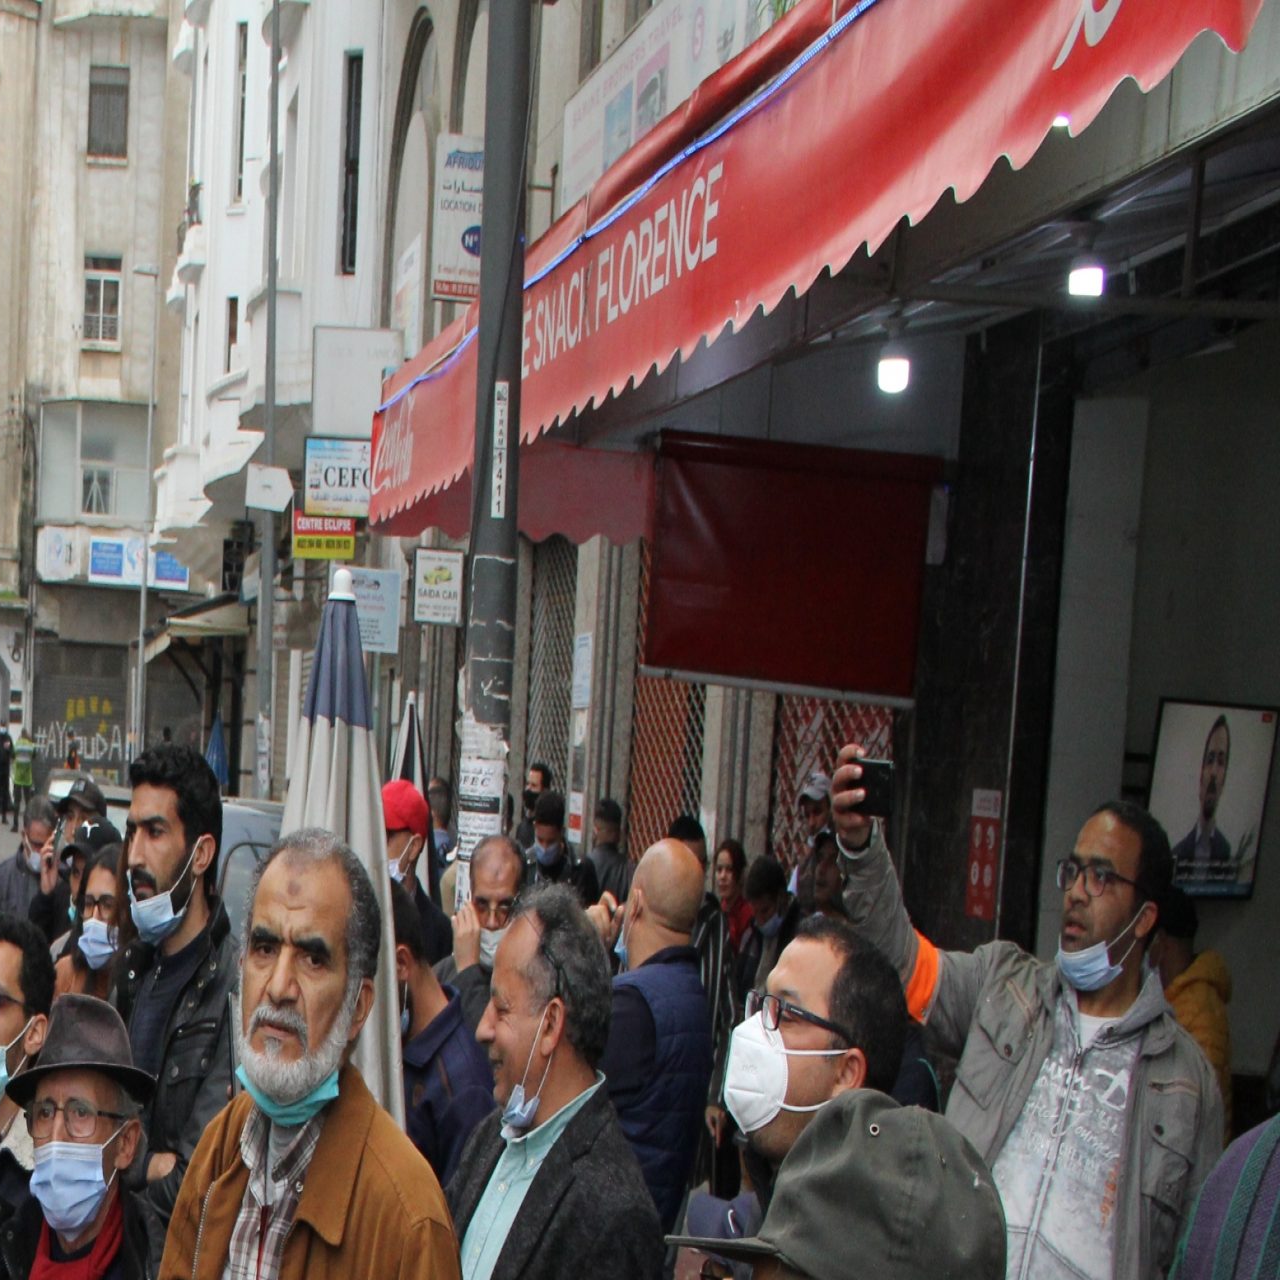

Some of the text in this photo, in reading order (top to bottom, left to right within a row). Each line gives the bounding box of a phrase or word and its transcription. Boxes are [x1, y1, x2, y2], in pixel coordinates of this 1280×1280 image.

[440, 200, 476, 213] LOCATION
[595, 160, 725, 332] FLORENCE
[297, 518, 352, 532] CENTRE ECLIPSE
[417, 587, 459, 601] SAIDA CAR
